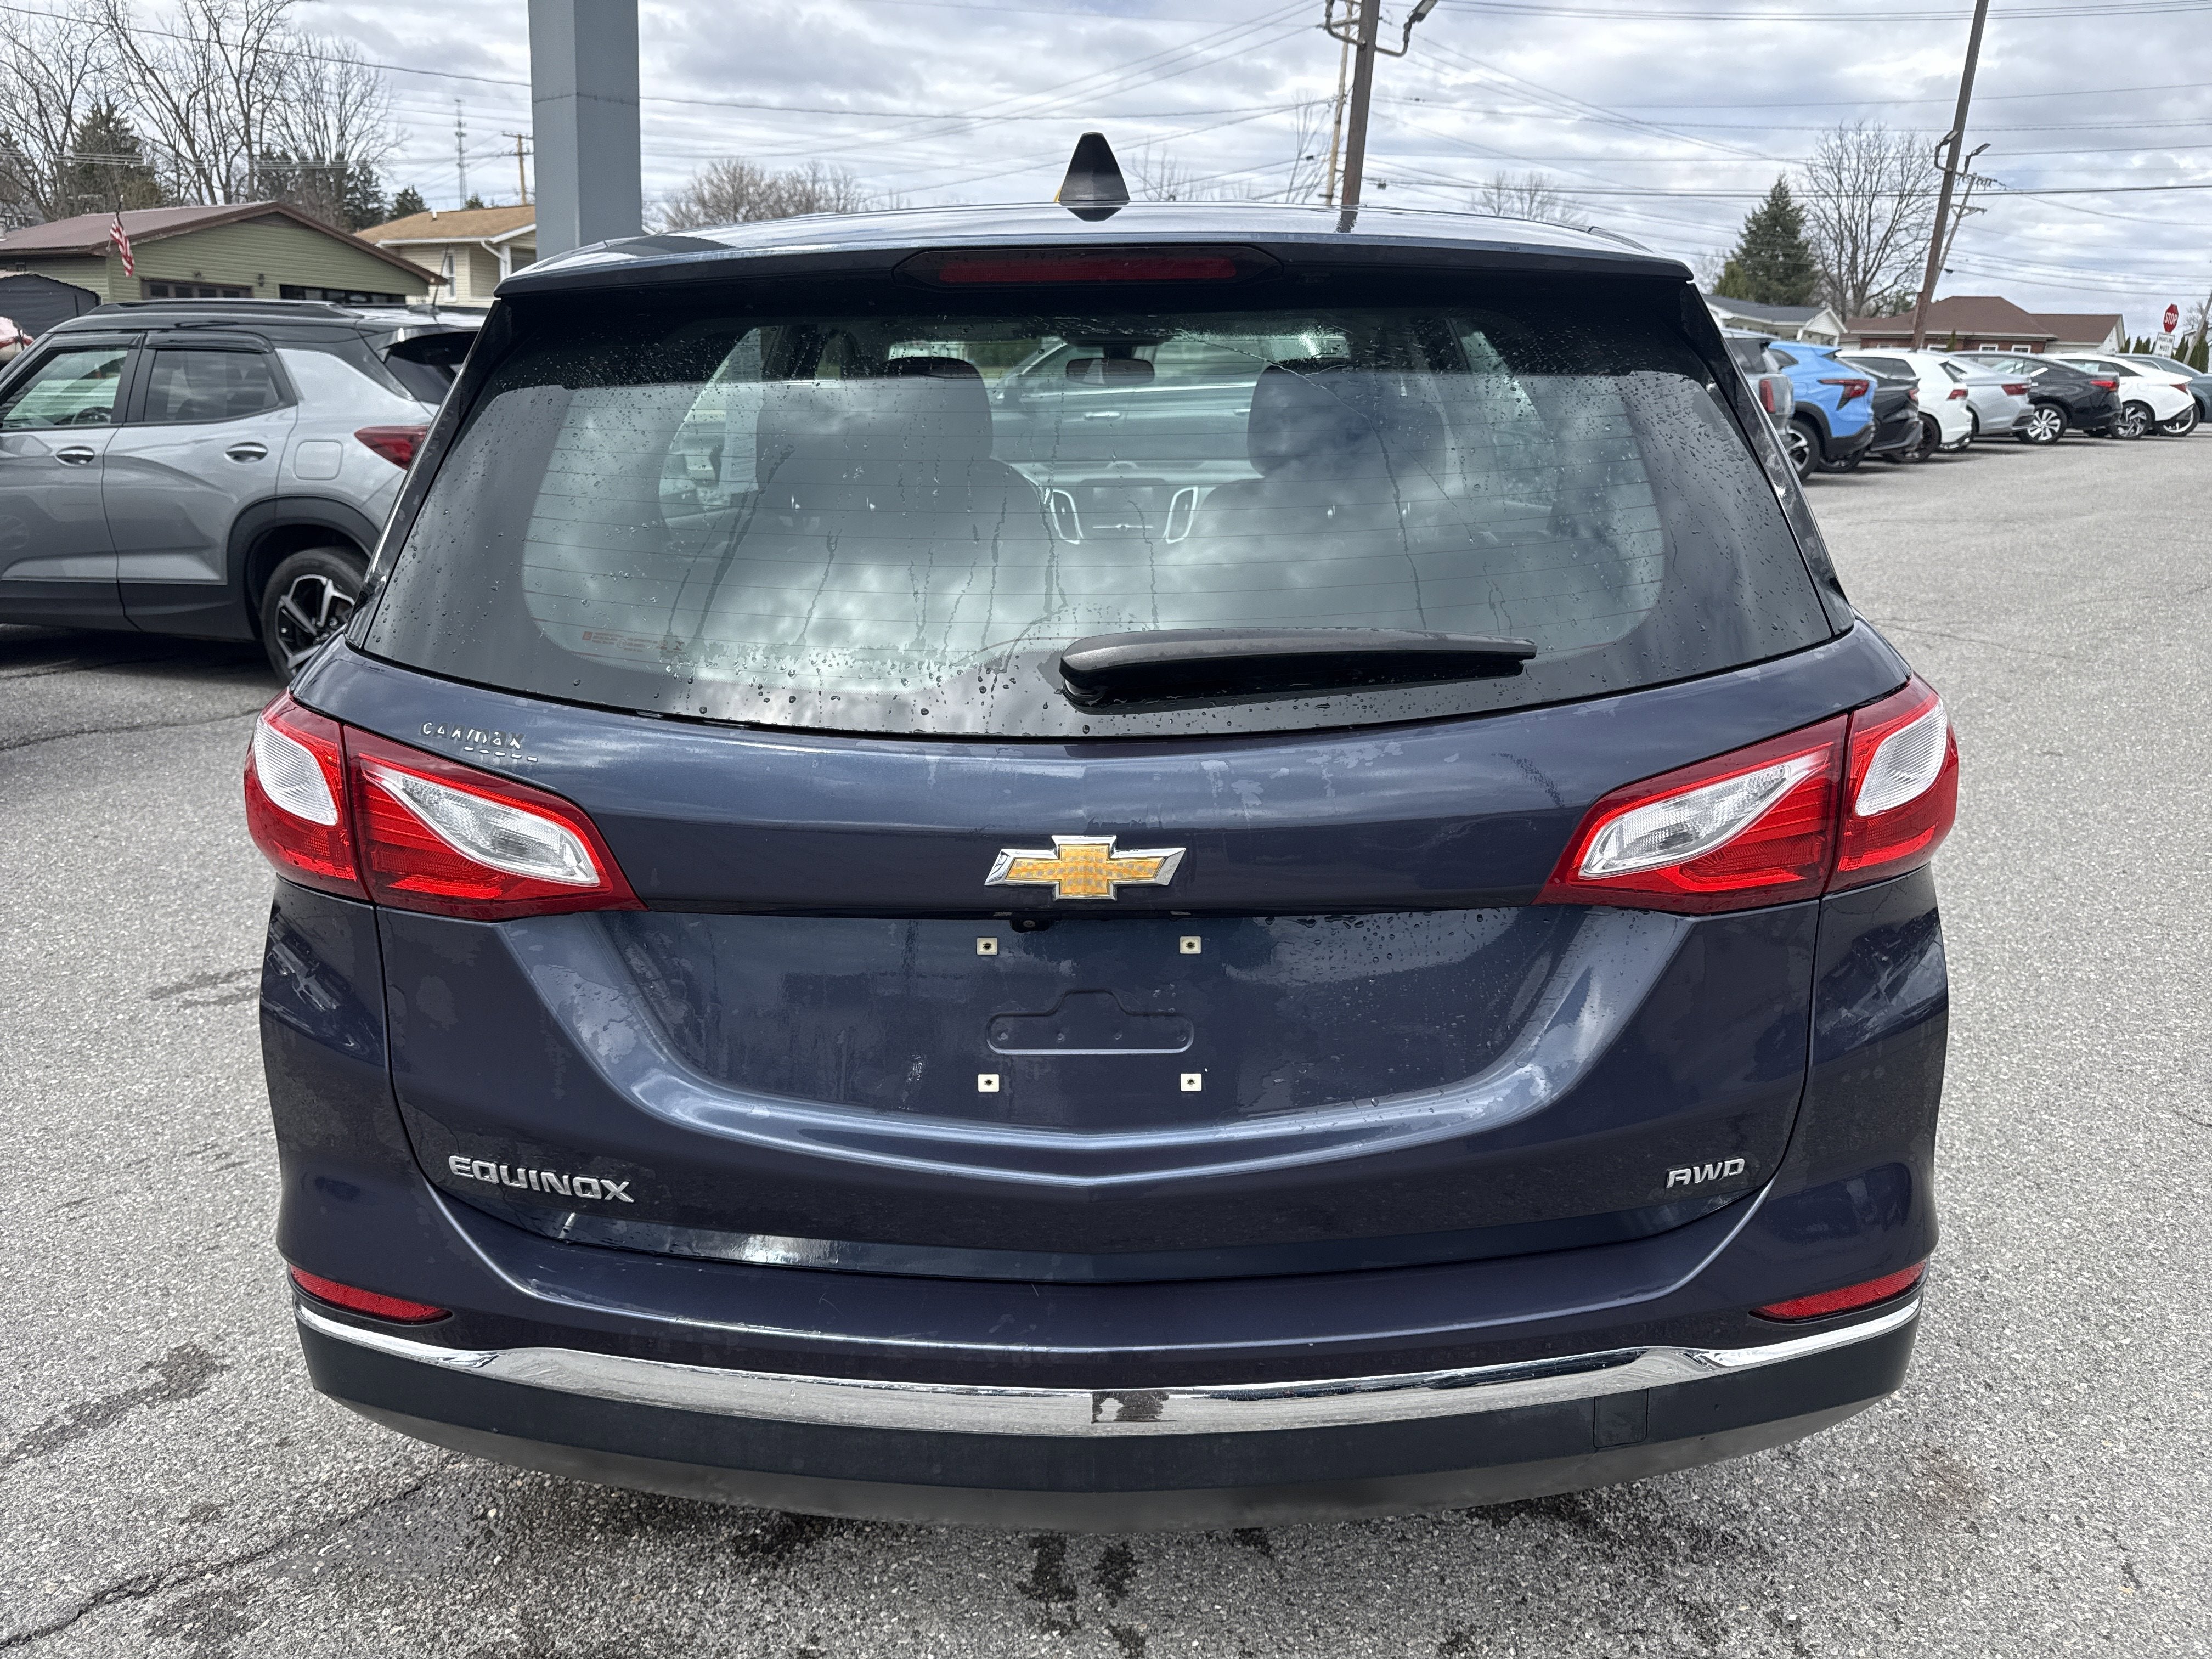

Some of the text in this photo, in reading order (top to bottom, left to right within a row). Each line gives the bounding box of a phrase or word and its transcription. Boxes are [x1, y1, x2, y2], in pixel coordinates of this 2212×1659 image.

[2165, 312, 2178, 325] STOP
[448, 1154, 635, 1204] EQUINOX
[1666, 1158, 1745, 1188] AWD
